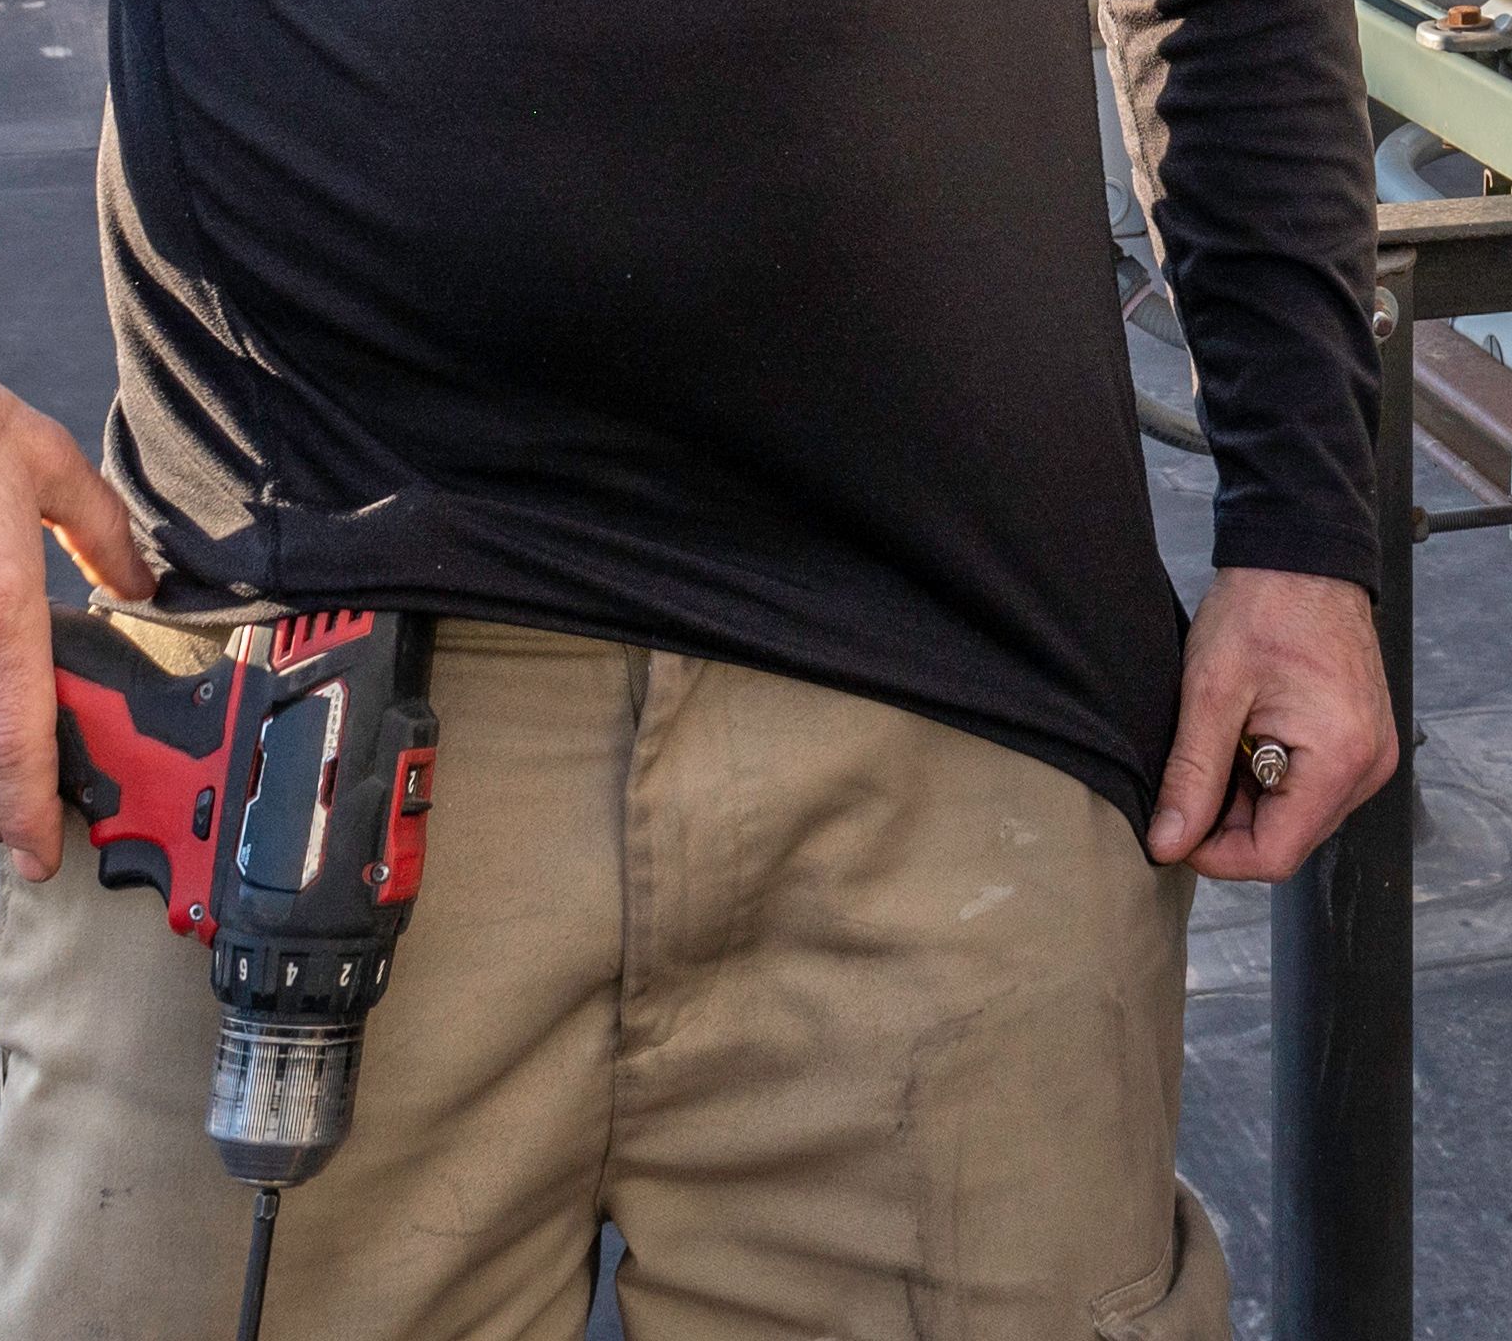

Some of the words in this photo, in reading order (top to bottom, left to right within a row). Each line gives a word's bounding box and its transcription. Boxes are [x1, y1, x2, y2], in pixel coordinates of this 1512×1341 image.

[408, 770, 417, 794] 2
[285, 961, 299, 987] 4
[339, 962, 353, 987] 2
